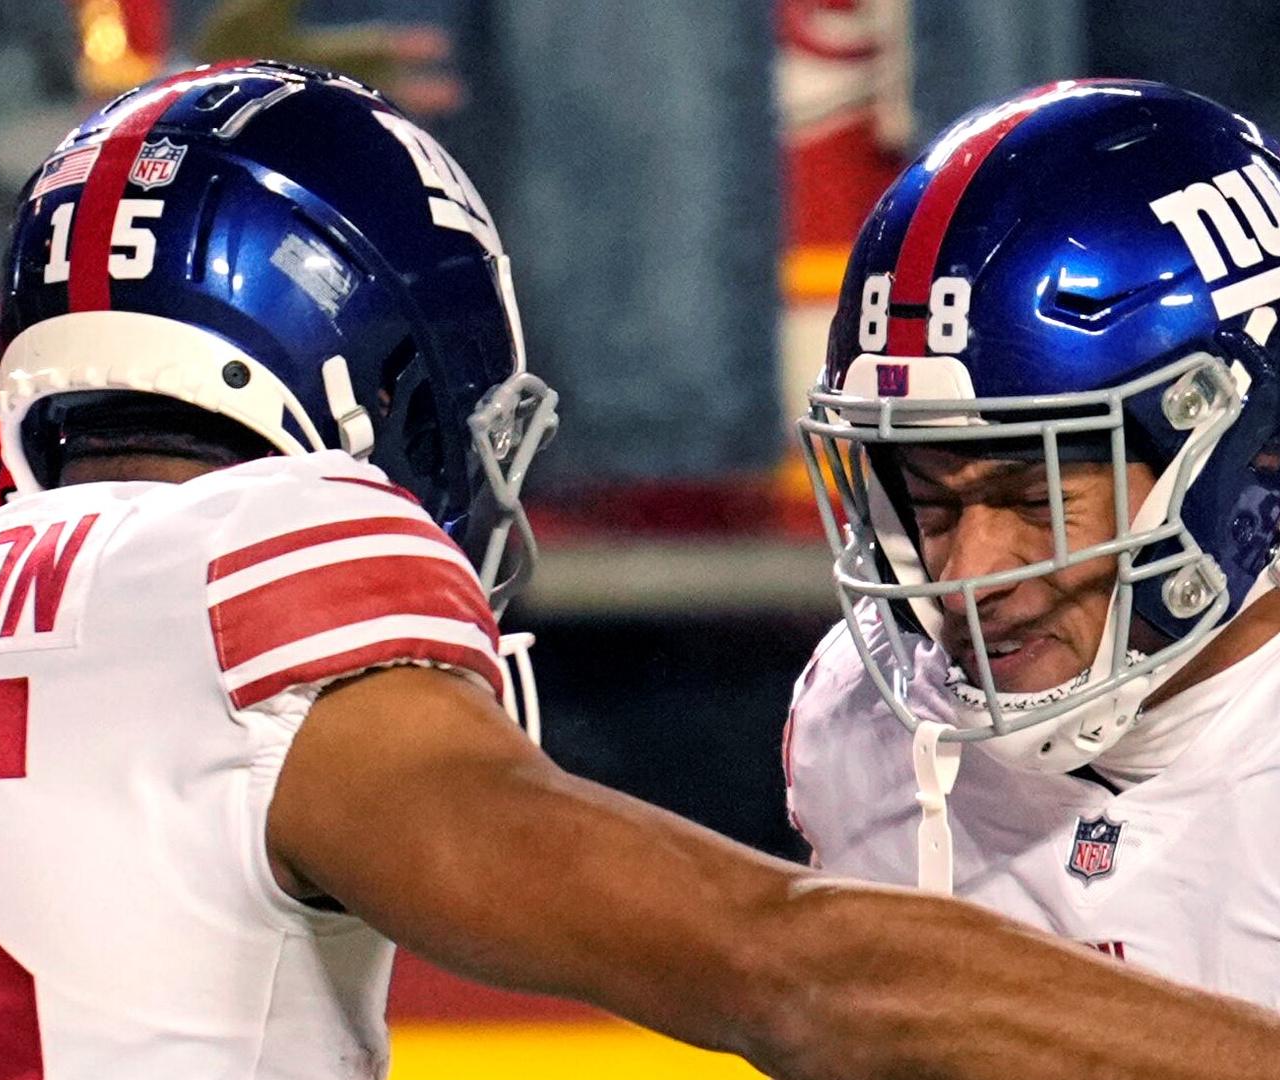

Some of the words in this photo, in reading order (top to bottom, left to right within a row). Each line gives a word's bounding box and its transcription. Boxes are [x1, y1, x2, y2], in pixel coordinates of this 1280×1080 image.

[135, 160, 169, 182] NFL
[44, 199, 165, 284] 15
[859, 275, 971, 354] 88
[1075, 842, 1110, 873] NFL
